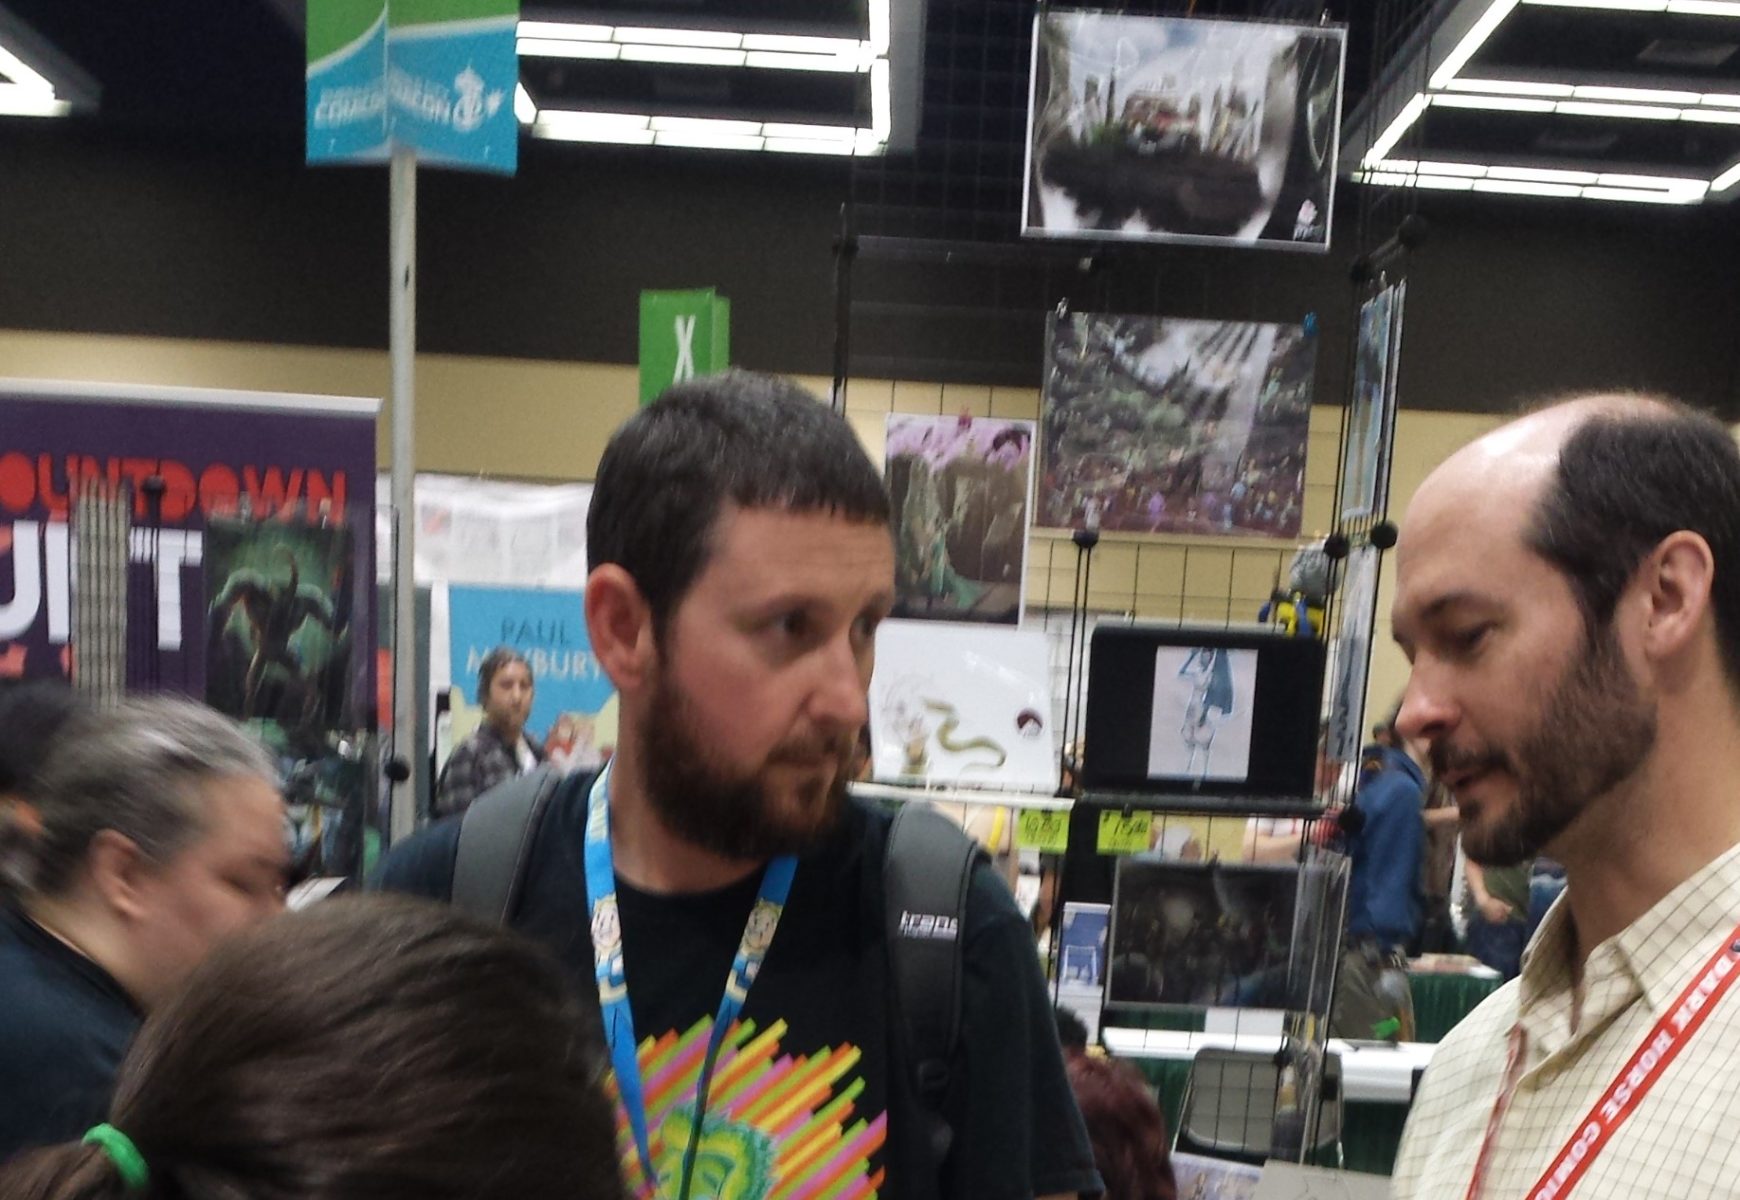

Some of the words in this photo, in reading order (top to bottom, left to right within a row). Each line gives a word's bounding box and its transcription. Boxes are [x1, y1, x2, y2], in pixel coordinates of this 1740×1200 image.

[672, 313, 697, 384] X
[465, 644, 602, 681] MBURY
[500, 617, 570, 646] PAUL
[1671, 956, 1736, 1035] DARK
[1600, 1030, 1676, 1125] HORSE
